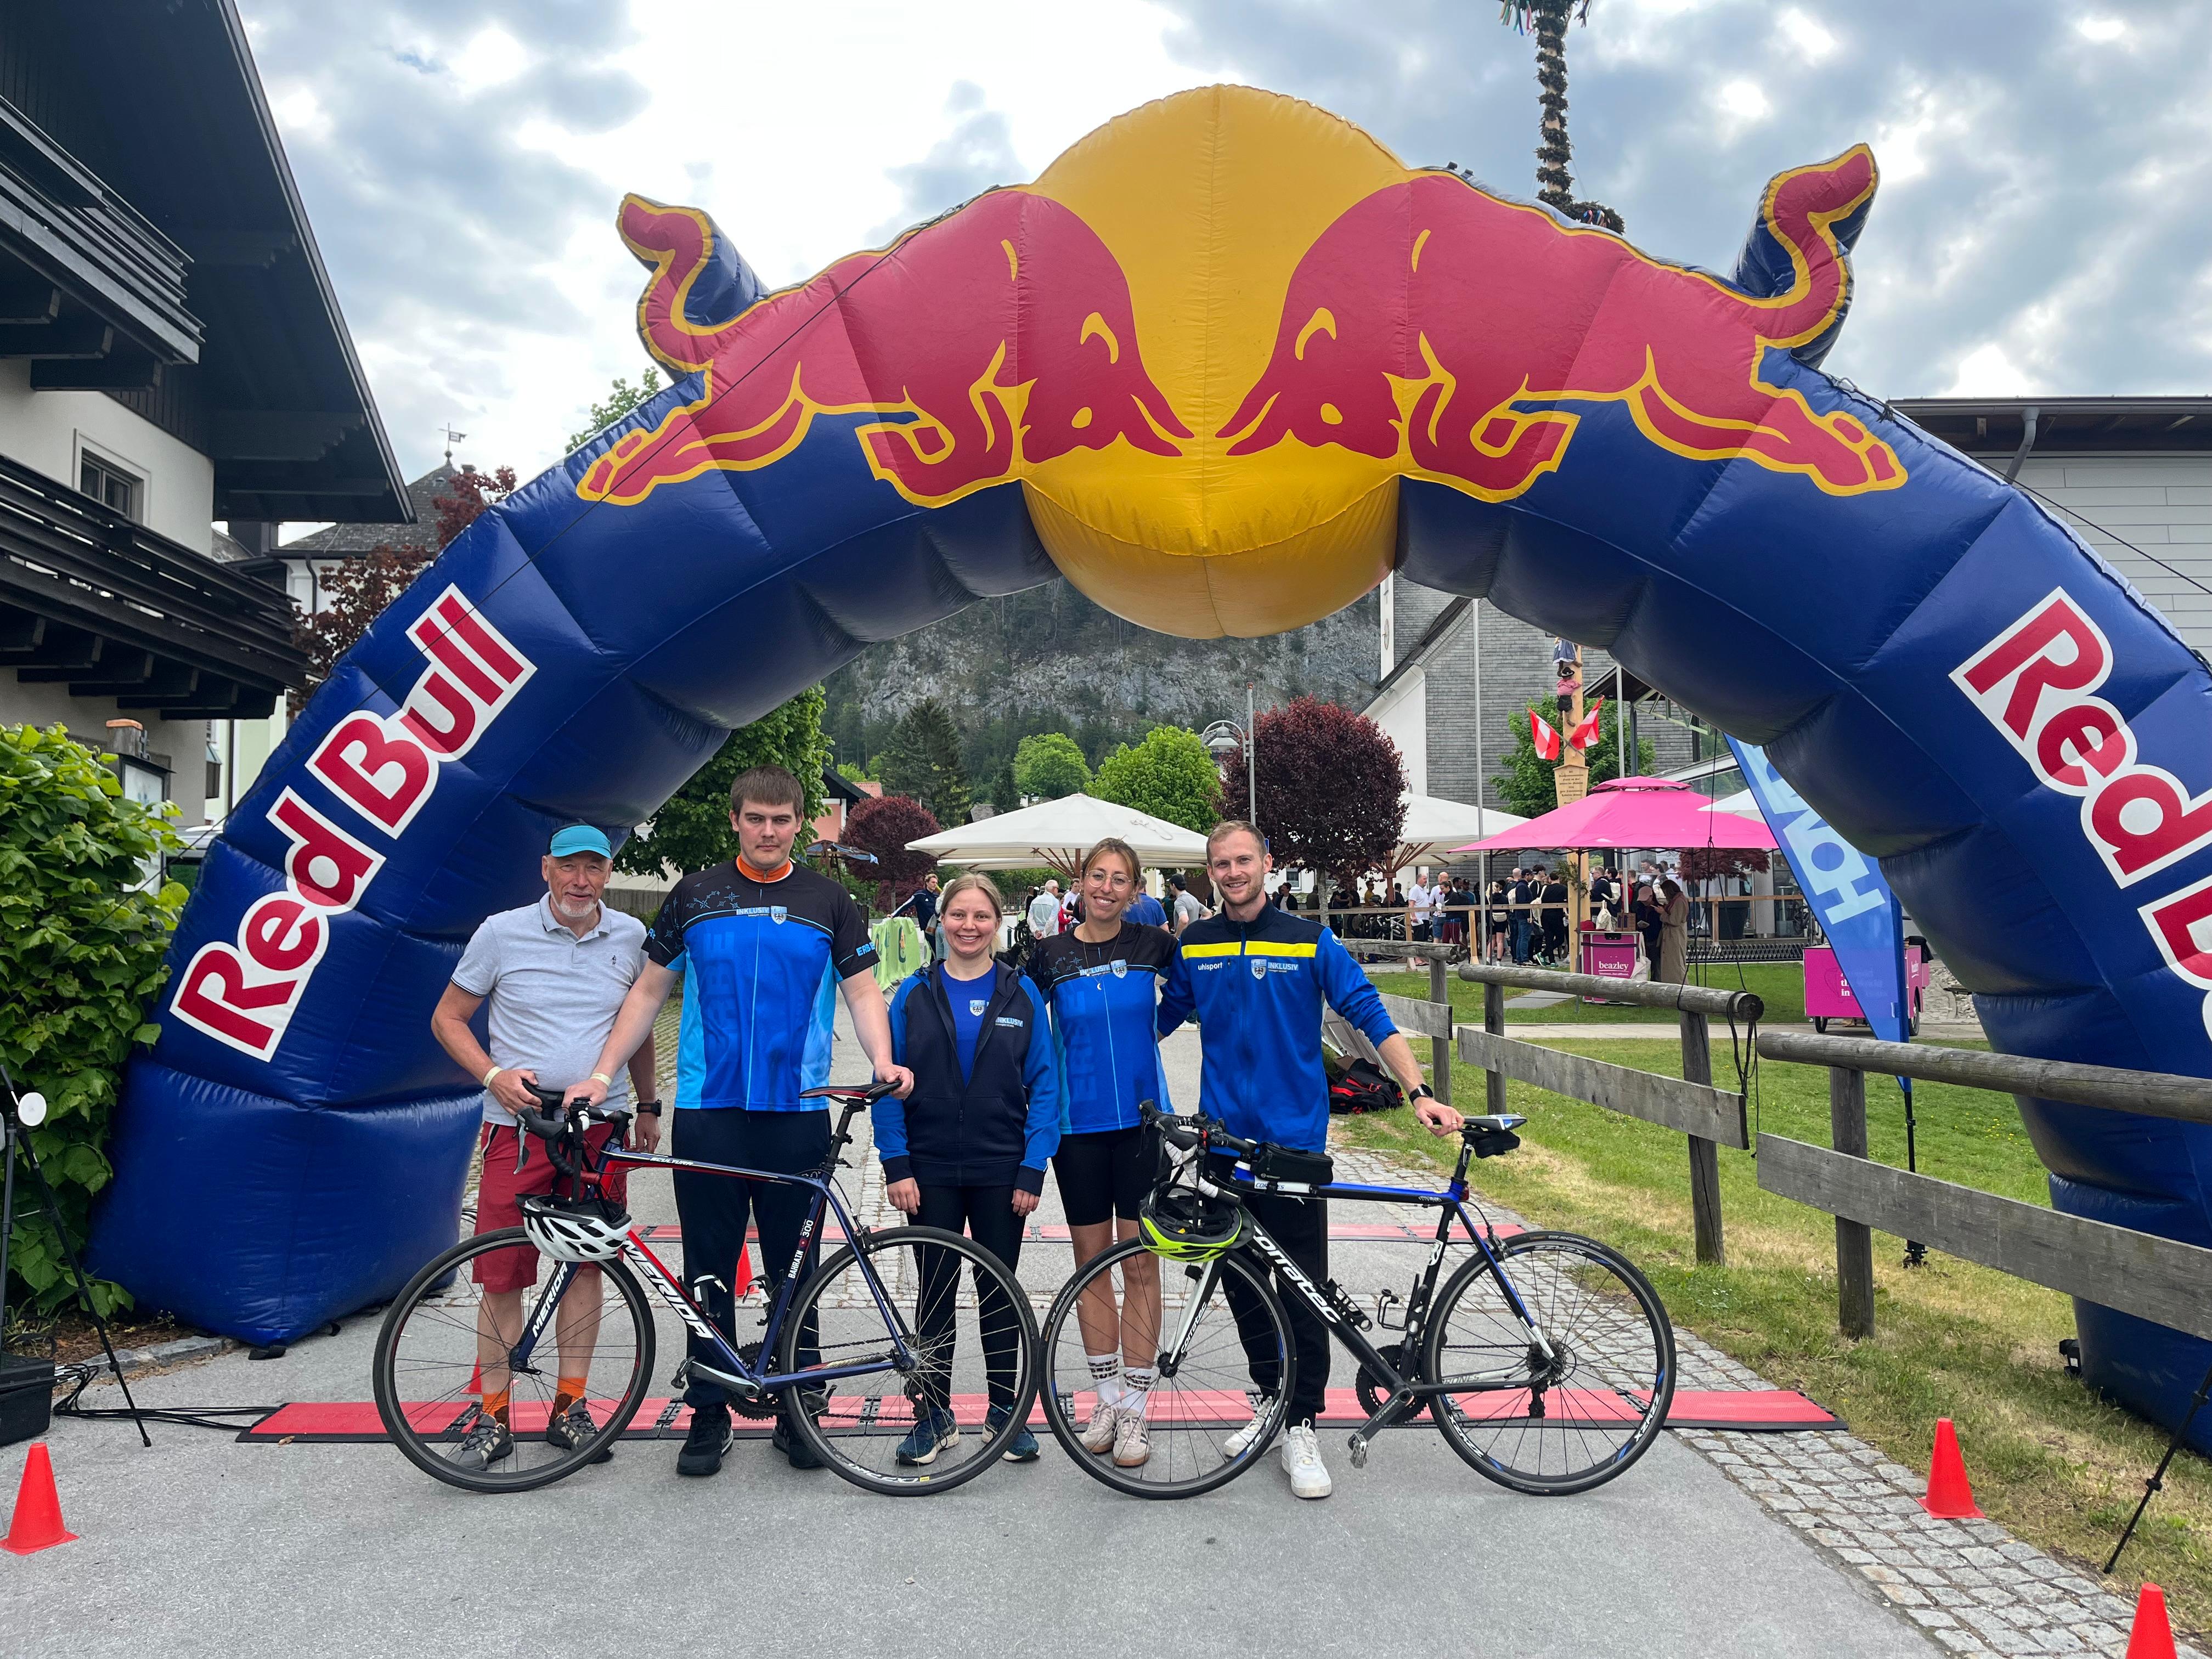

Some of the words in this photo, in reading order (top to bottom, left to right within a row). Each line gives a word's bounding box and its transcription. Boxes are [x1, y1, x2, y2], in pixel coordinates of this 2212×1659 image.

[1963, 598, 2212, 876] Red
[177, 797, 374, 1051] Red
[313, 594, 524, 828] Bull
[1198, 962, 1223, 971] uhlsport
[1268, 962, 1299, 970] INKLUSIV
[1599, 961, 1629, 971] beazley
[787, 1250, 804, 1279] BAHRAIN
[802, 1219, 814, 1238] 300
[1253, 1225, 1341, 1324] corratec
[533, 1261, 567, 1338] MERIDA
[623, 1240, 714, 1339] MERIDA
[1181, 1301, 1207, 1353] corratec
[1375, 1398, 1398, 1422] ULTEGRA
